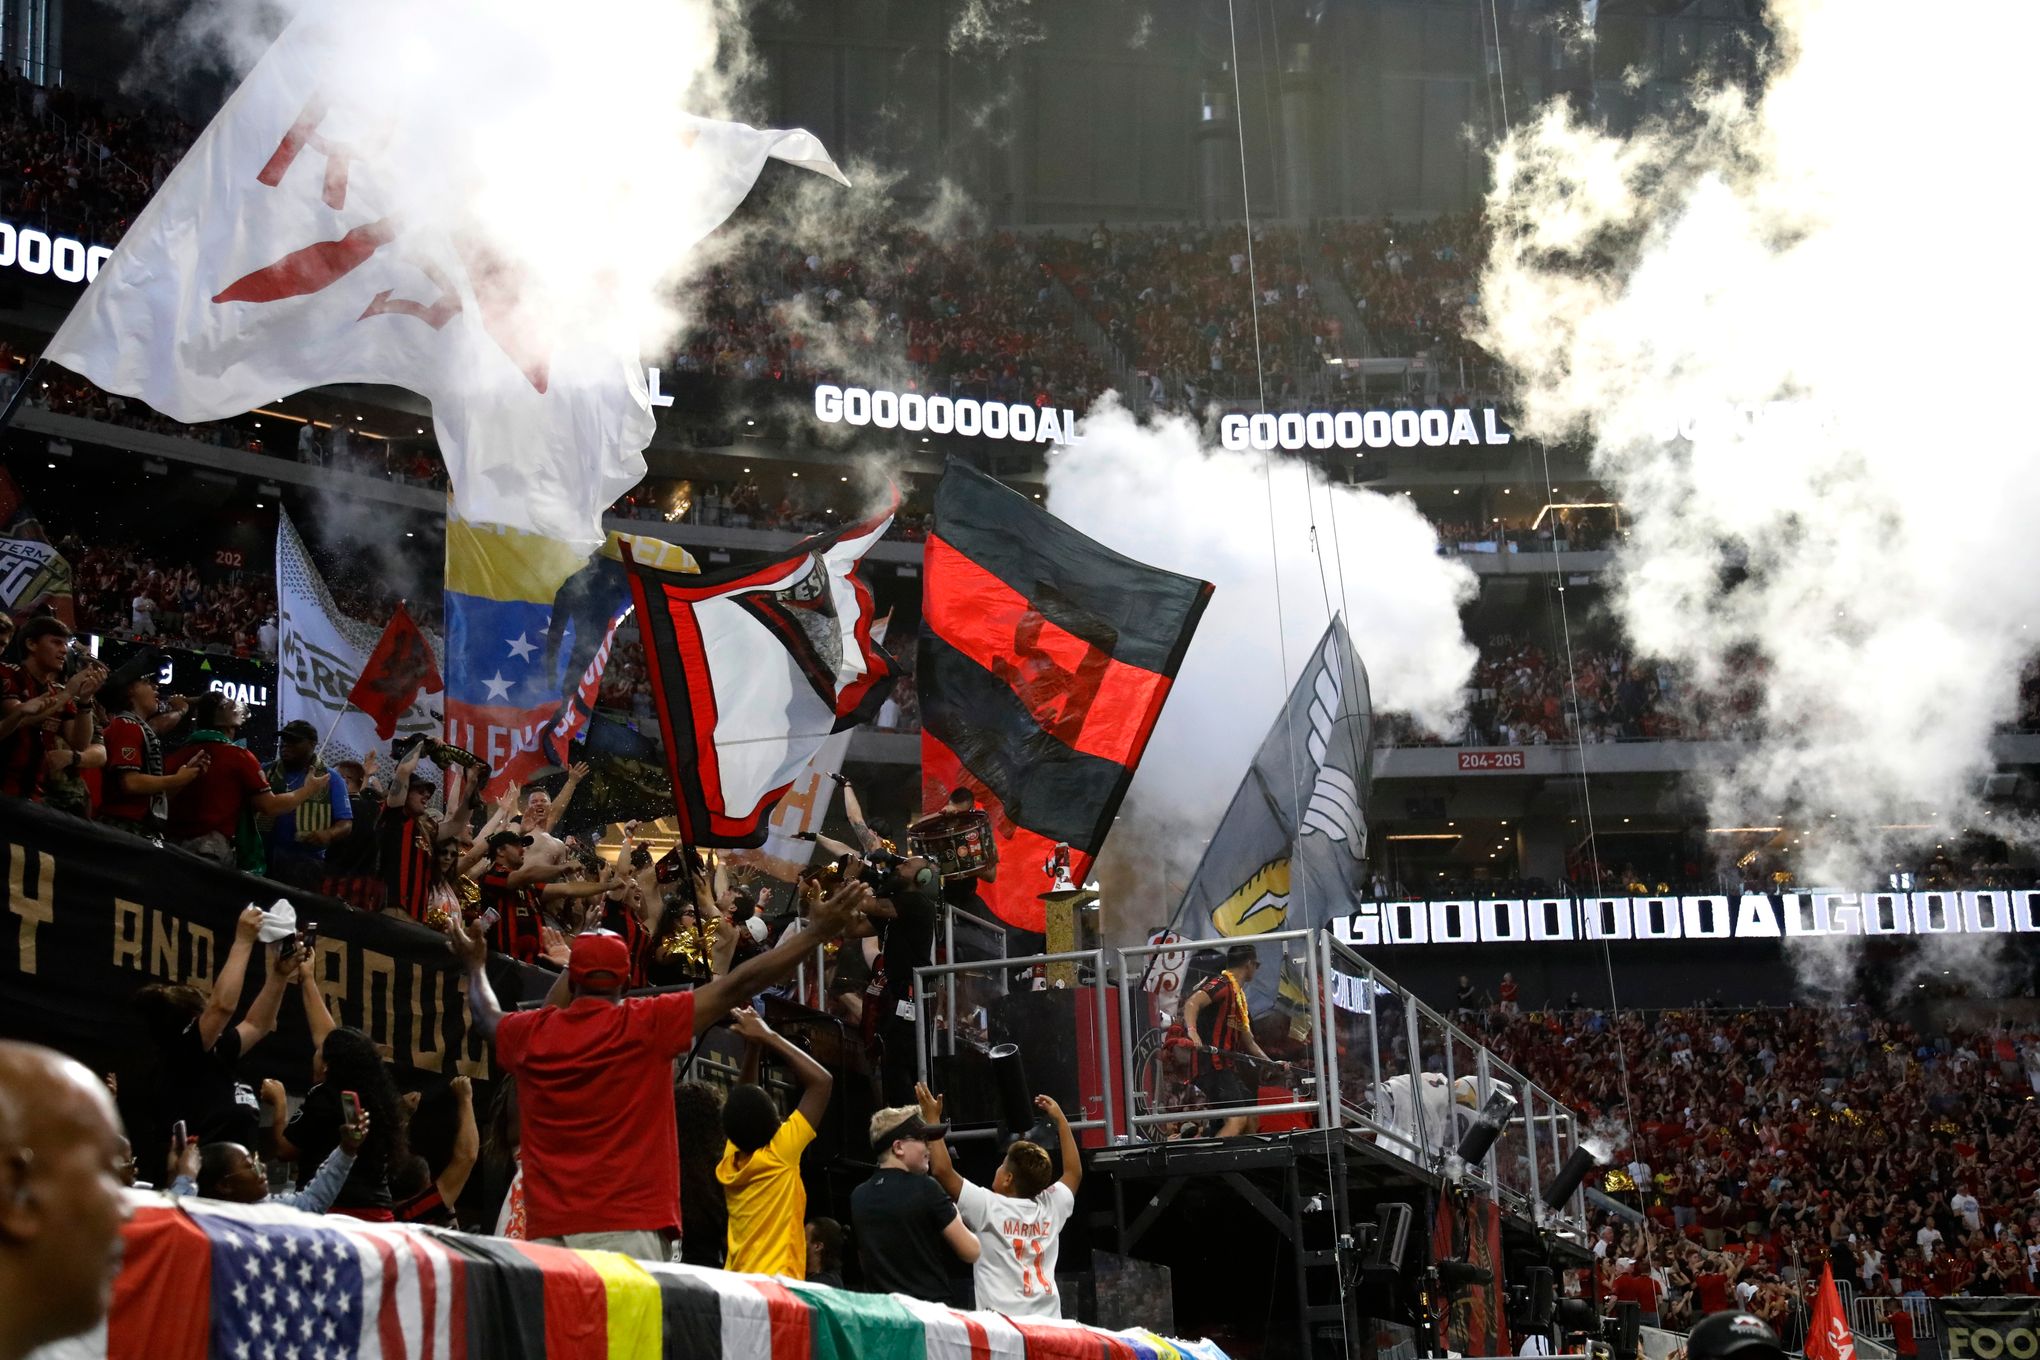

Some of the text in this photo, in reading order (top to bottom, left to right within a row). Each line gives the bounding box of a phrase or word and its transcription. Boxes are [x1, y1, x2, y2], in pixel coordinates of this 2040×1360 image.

[1221, 408, 1510, 450] GOOOOOOOAL
[216, 551, 242, 567] 202
[210, 679, 267, 706] GOAL!
[1461, 754, 1522, 768] 204-205
[113, 897, 214, 996] AND
[1013, 1238, 1052, 1296] 11
[1947, 1326, 2040, 1360] FOO
